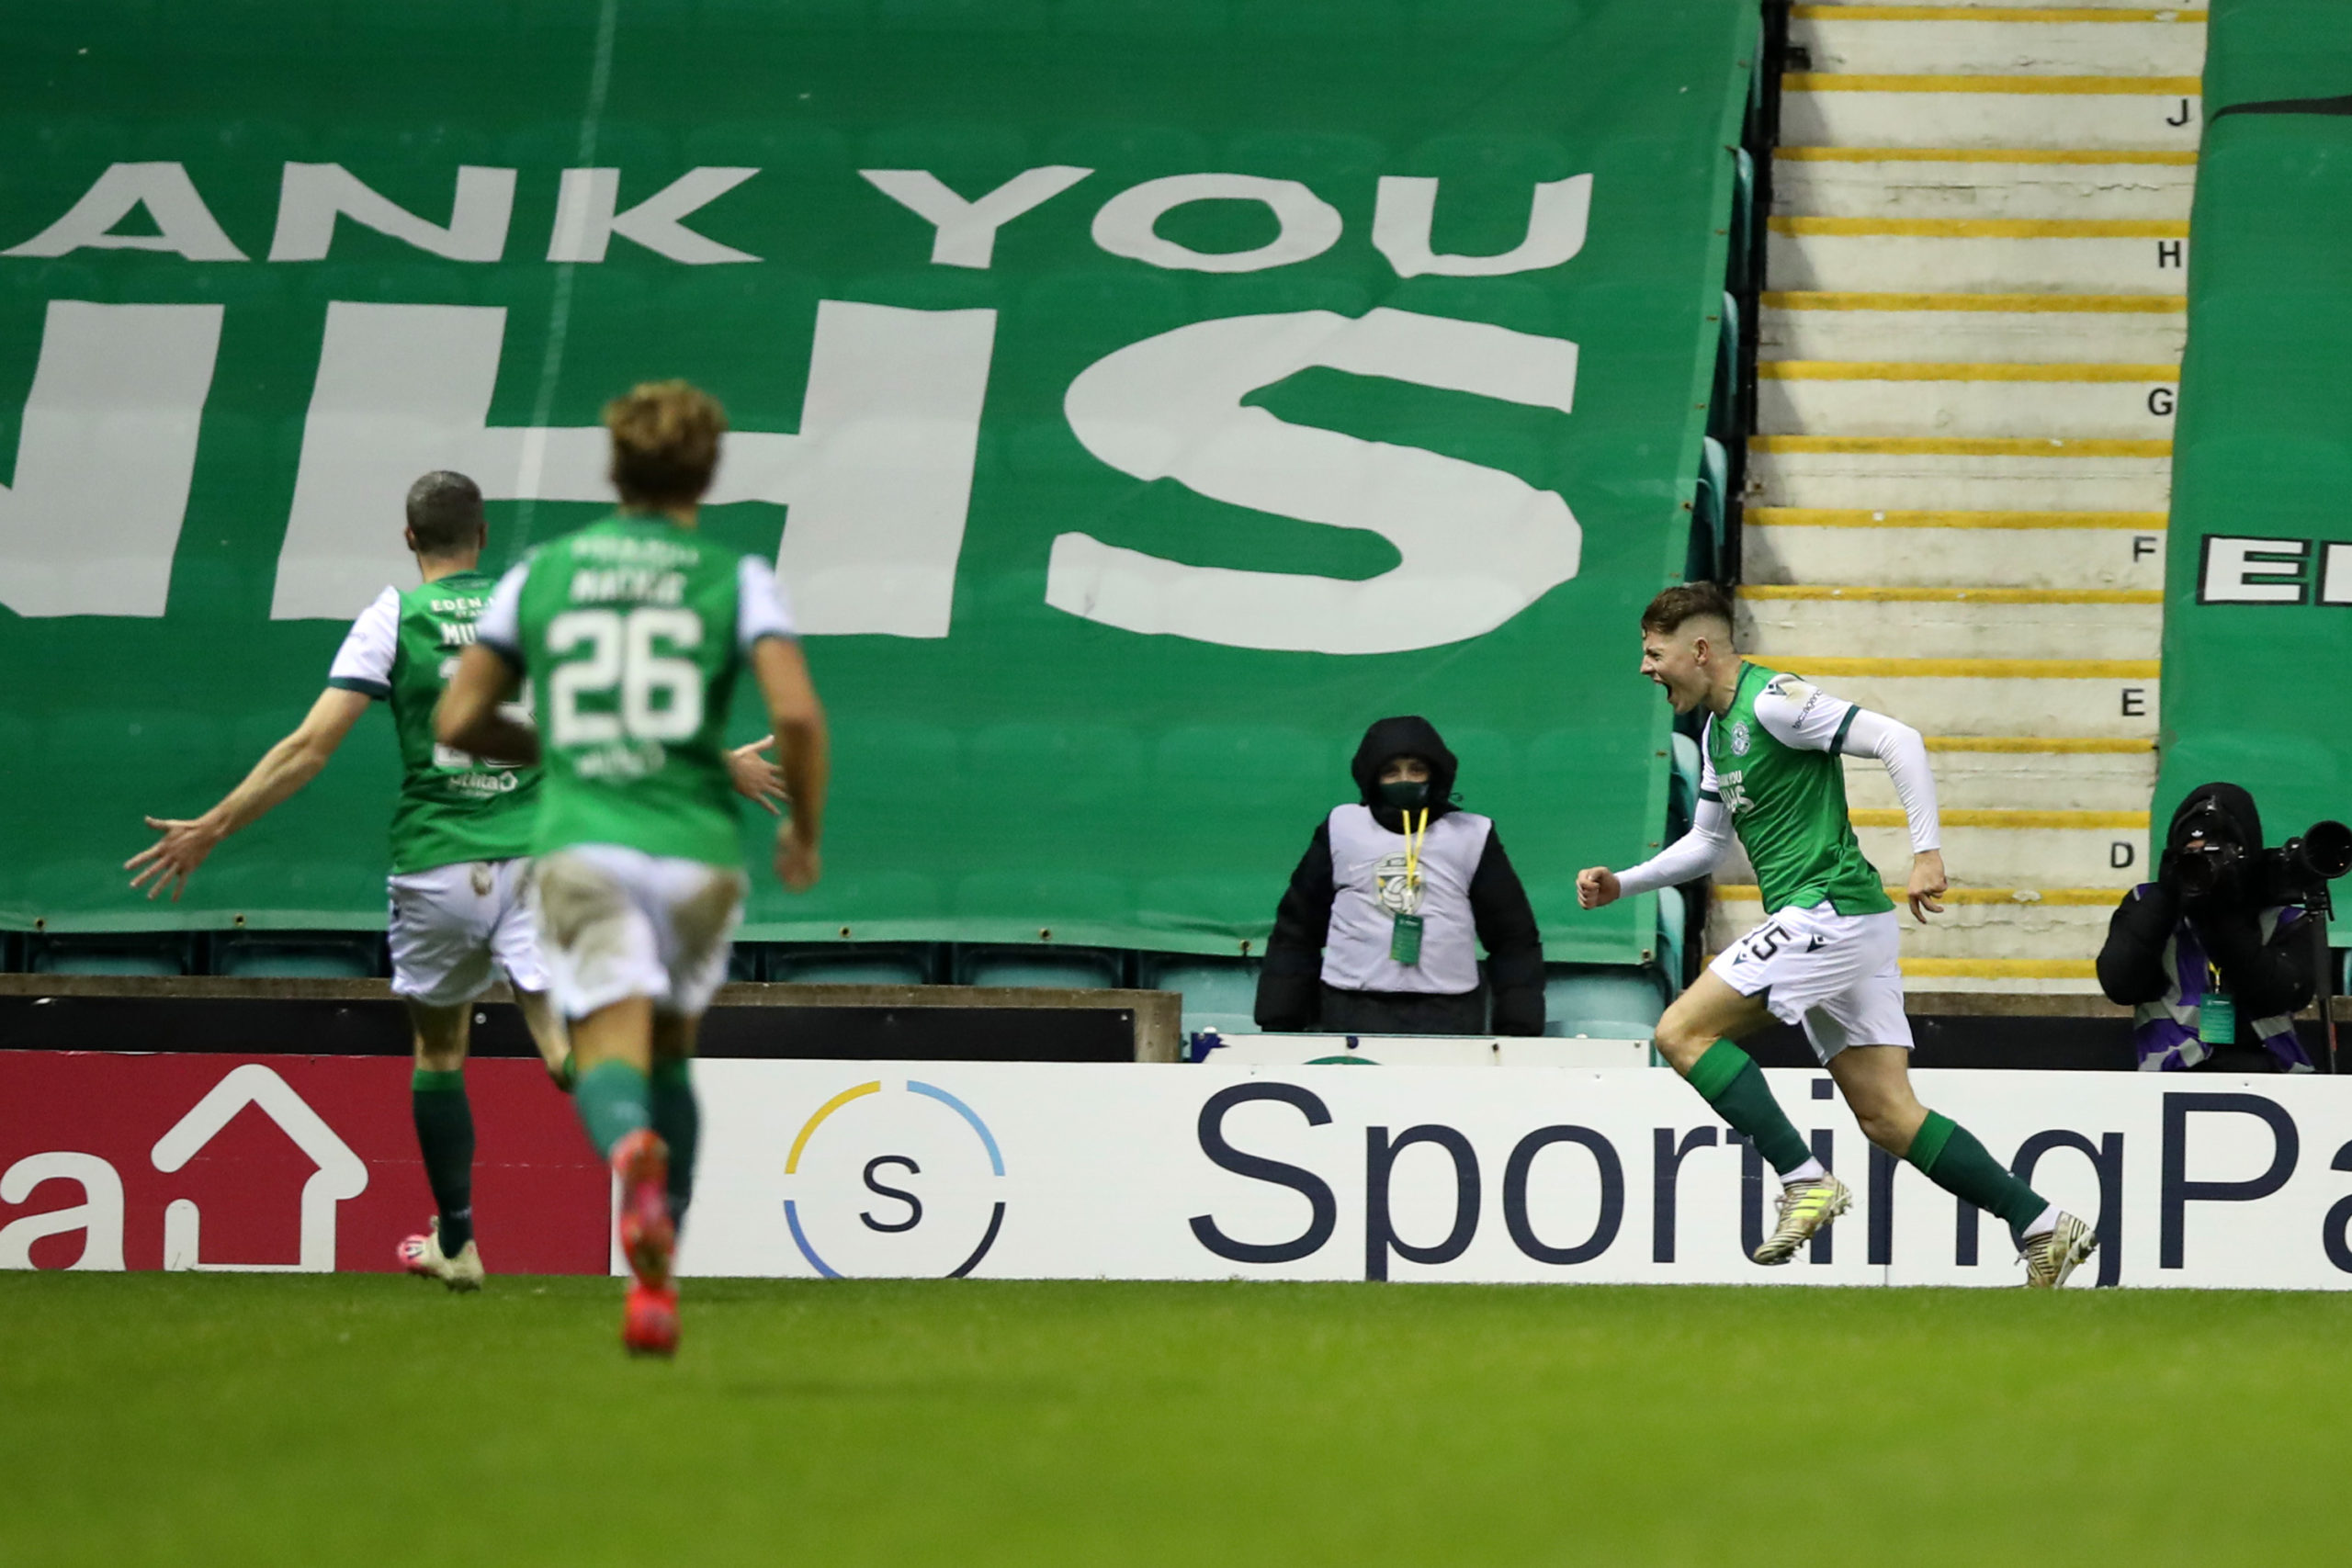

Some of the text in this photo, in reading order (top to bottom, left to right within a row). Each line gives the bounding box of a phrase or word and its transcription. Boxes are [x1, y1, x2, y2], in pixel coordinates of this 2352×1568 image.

[2165, 98, 2189, 127] J
[858, 165, 1594, 278] YOU
[2158, 240, 2182, 268] H
[2147, 388, 2173, 416] G
[2133, 536, 2156, 562] F
[548, 607, 704, 746] 26
[2121, 689, 2145, 716] E
[2110, 842, 2135, 868] D
[860, 1155, 922, 1233] S
